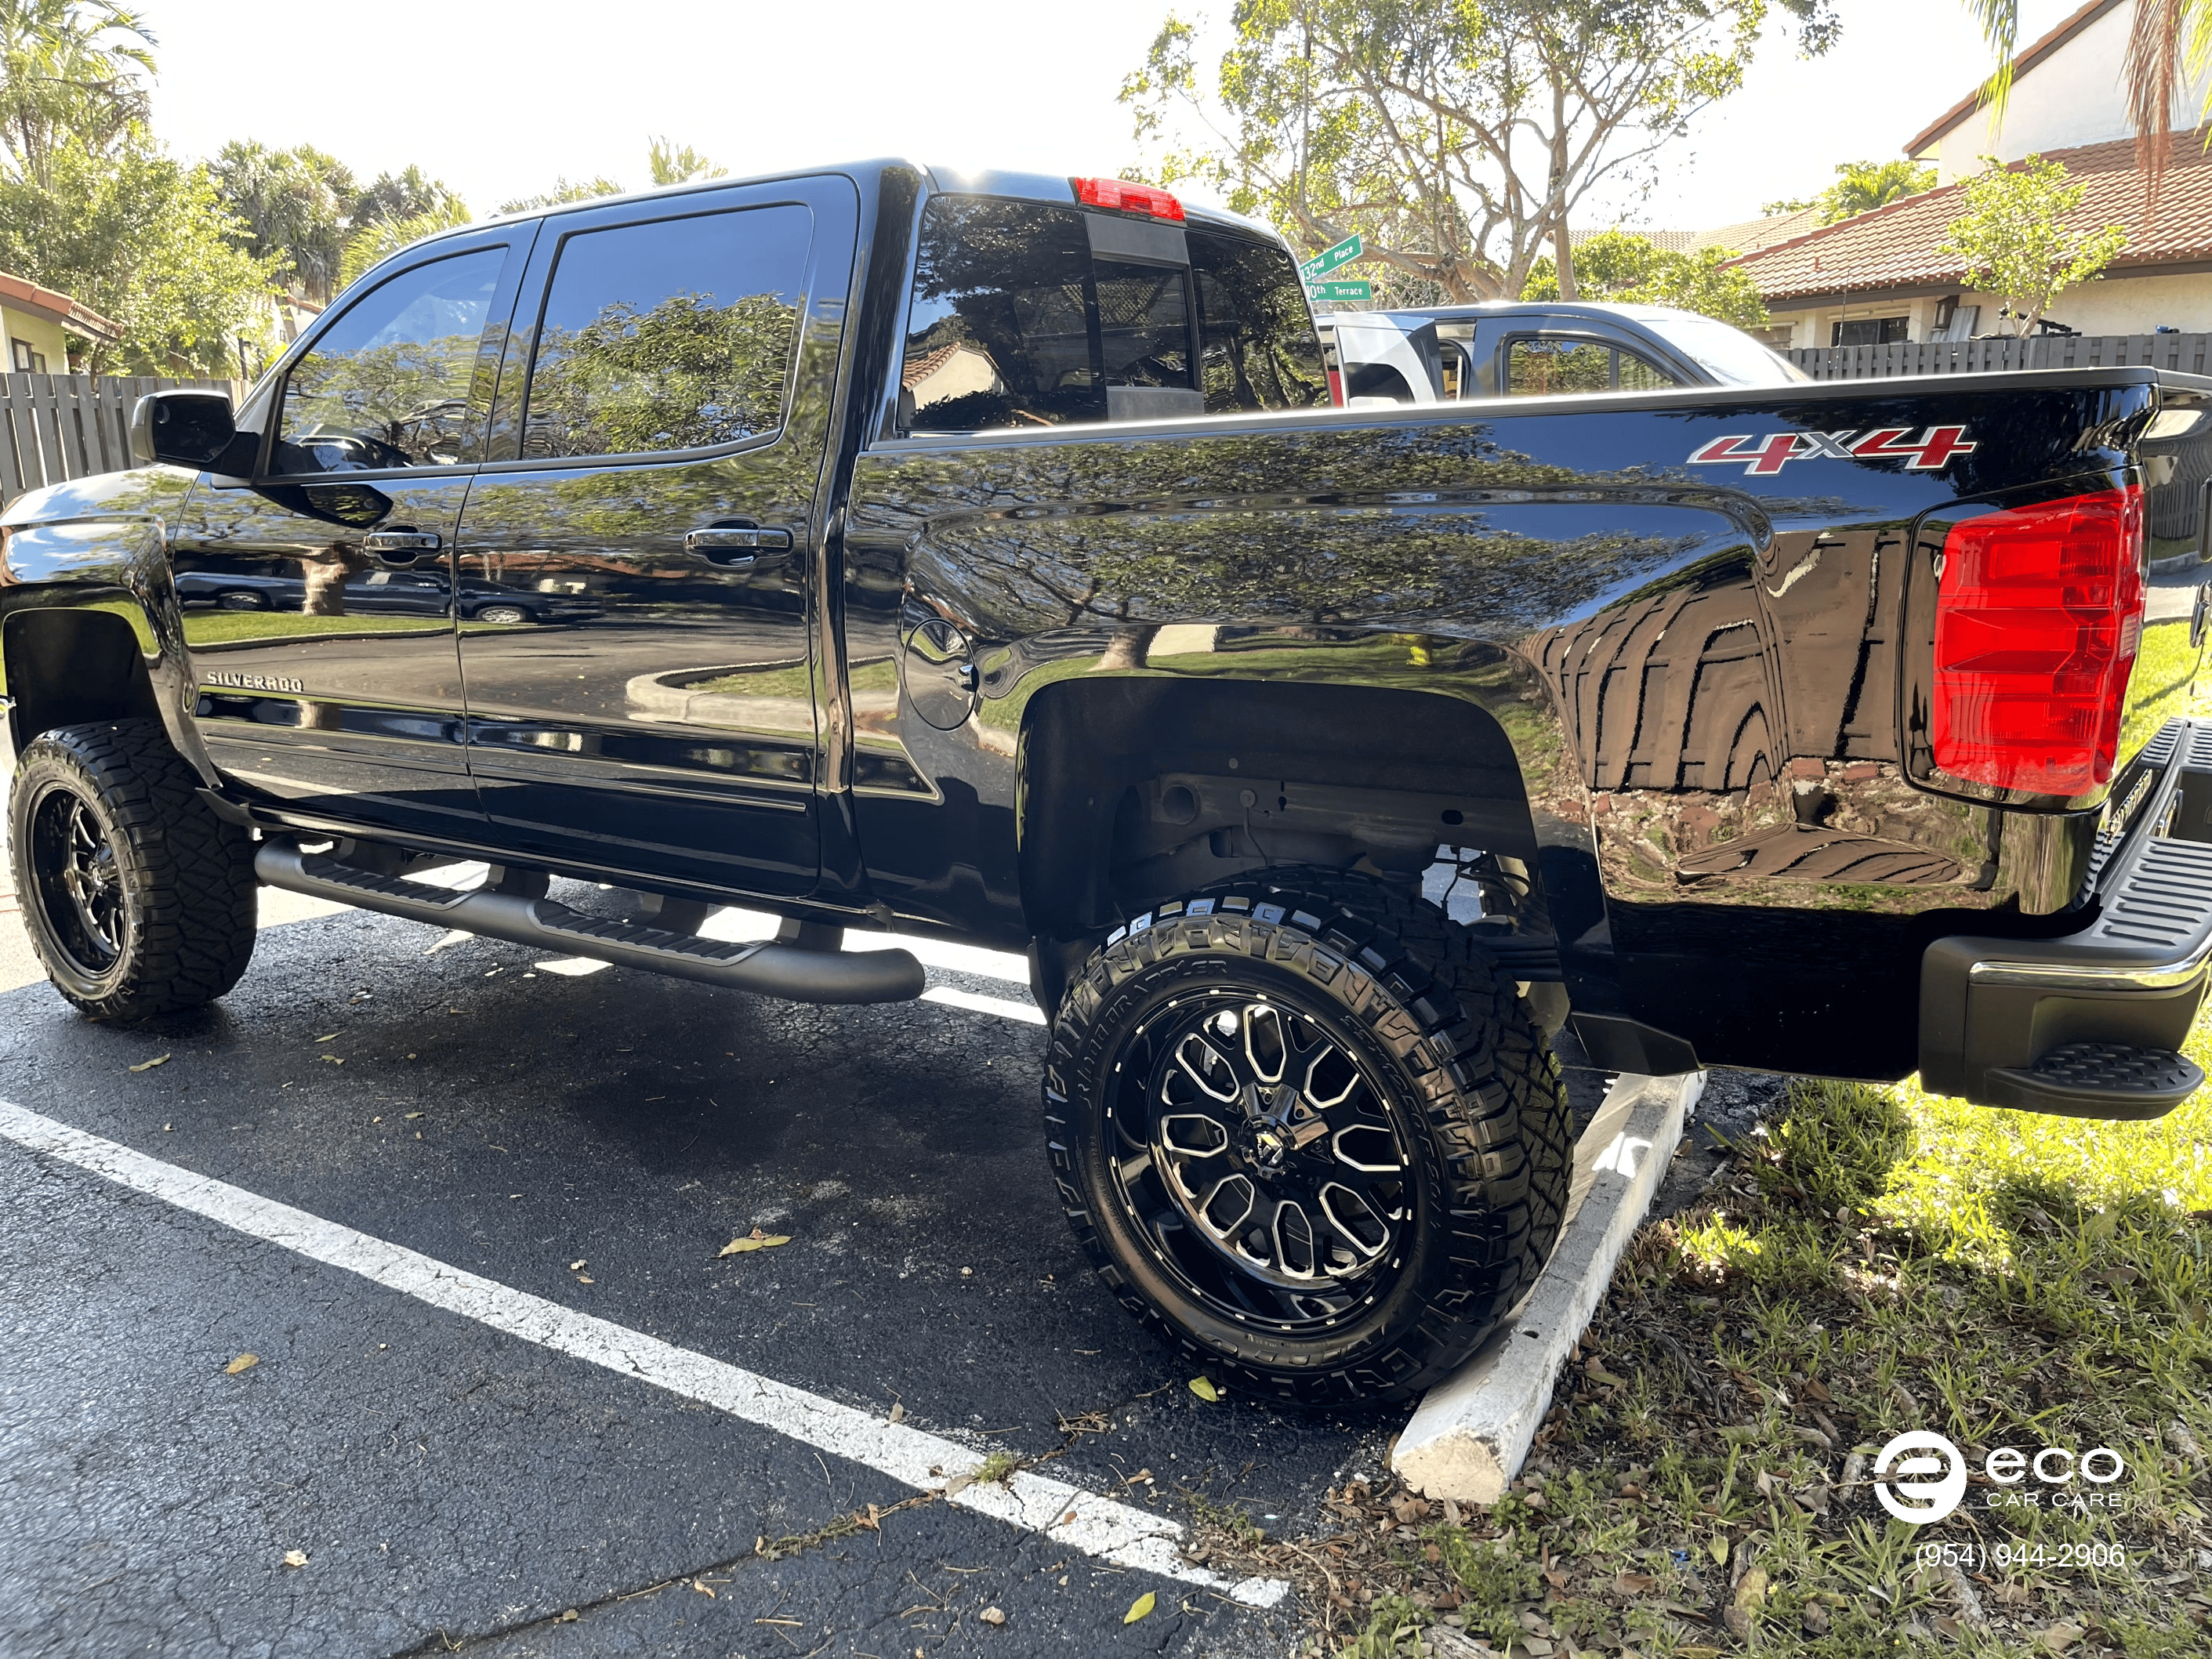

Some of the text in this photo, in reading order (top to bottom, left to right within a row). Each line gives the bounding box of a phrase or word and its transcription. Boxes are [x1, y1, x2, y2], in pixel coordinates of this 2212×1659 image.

[1334, 245, 1354, 261] Place
[1335, 286, 1363, 295] Terrace
[207, 672, 304, 693] SILVERADO
